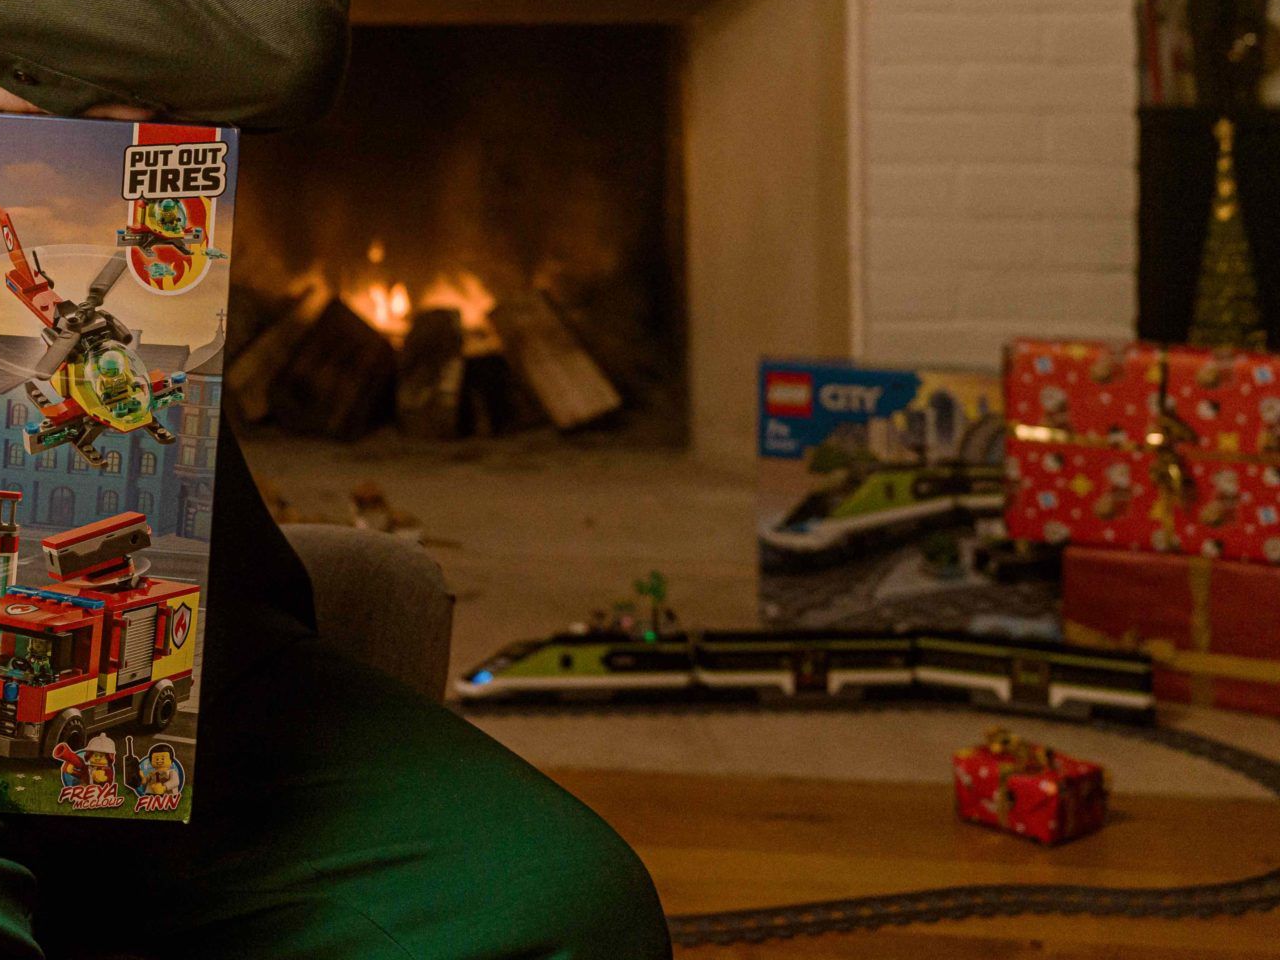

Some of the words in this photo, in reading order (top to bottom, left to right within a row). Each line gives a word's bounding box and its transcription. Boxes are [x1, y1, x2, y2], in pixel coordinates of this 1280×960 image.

[130, 150, 173, 167] PUT
[178, 148, 222, 166] OUT
[128, 167, 222, 194] FIRES
[60, 784, 118, 801] FREYA
[135, 795, 181, 811] FINN
